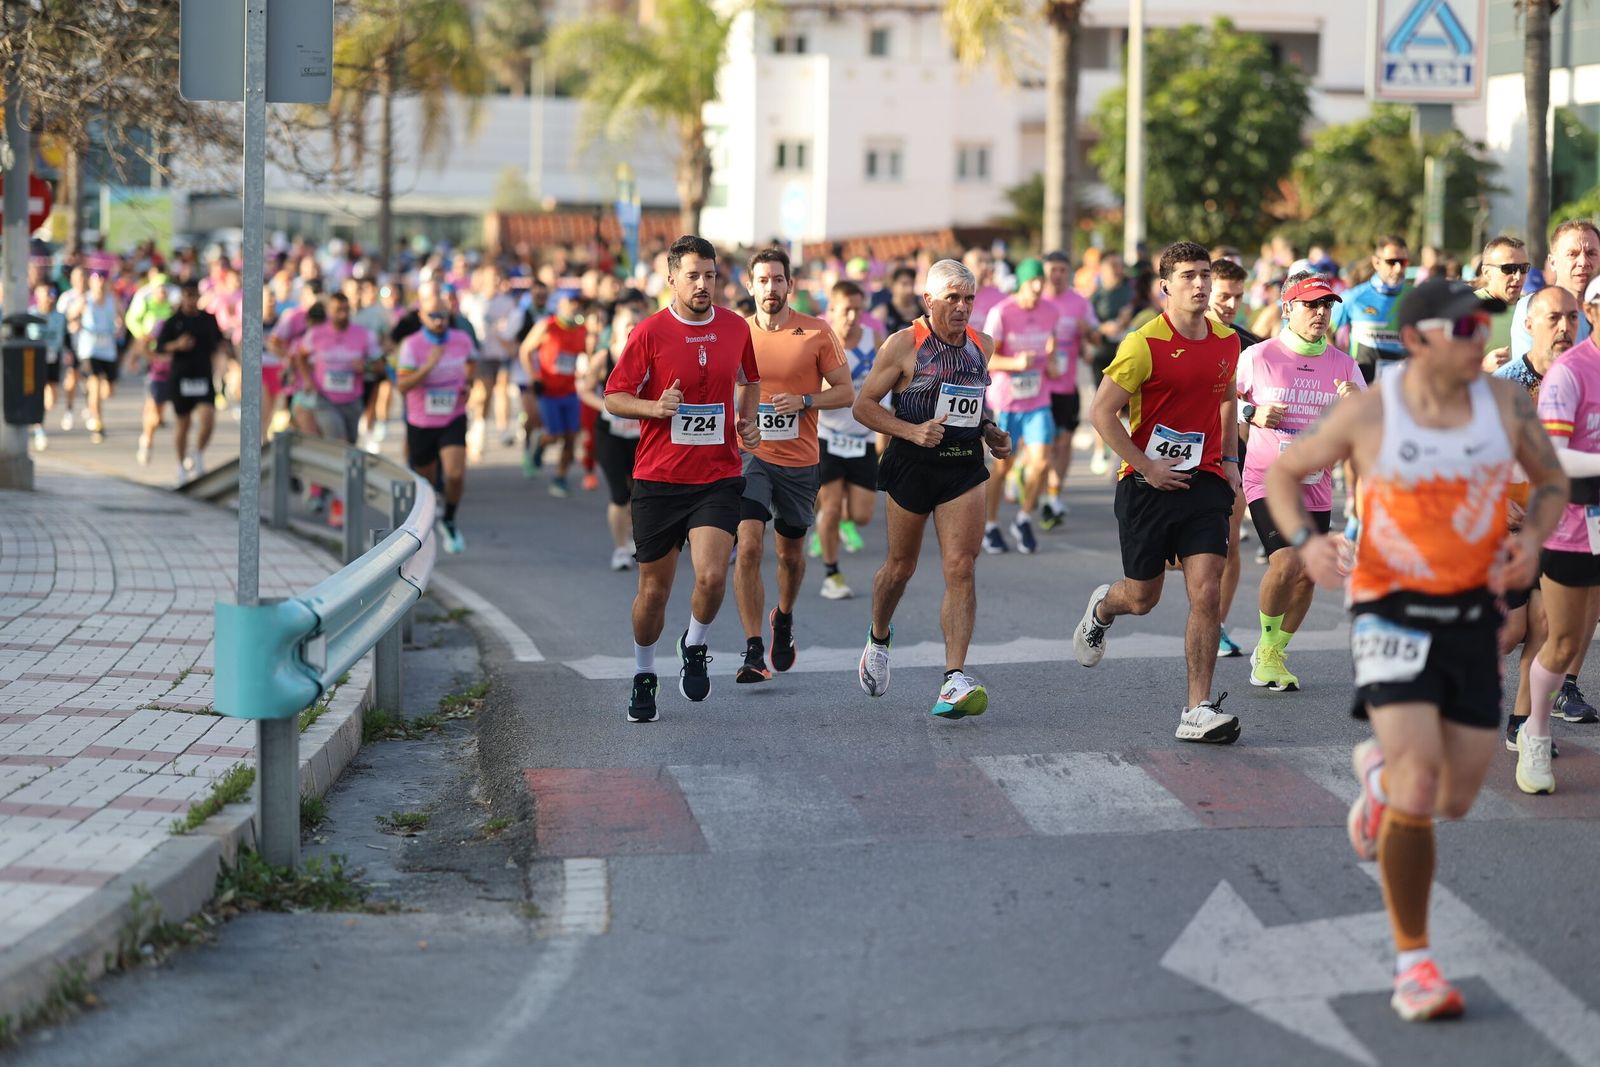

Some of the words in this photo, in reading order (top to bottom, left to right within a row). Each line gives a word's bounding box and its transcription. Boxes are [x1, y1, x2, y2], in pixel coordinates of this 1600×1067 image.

[1391, 62, 1466, 84] ALDI
[1293, 378, 1321, 389] XXXVI
[1262, 387, 1296, 402] MEDIA
[948, 397, 978, 414] 100
[1287, 404, 1322, 416] NACIONAL
[681, 416, 716, 432] 724
[1155, 441, 1192, 460] 464
